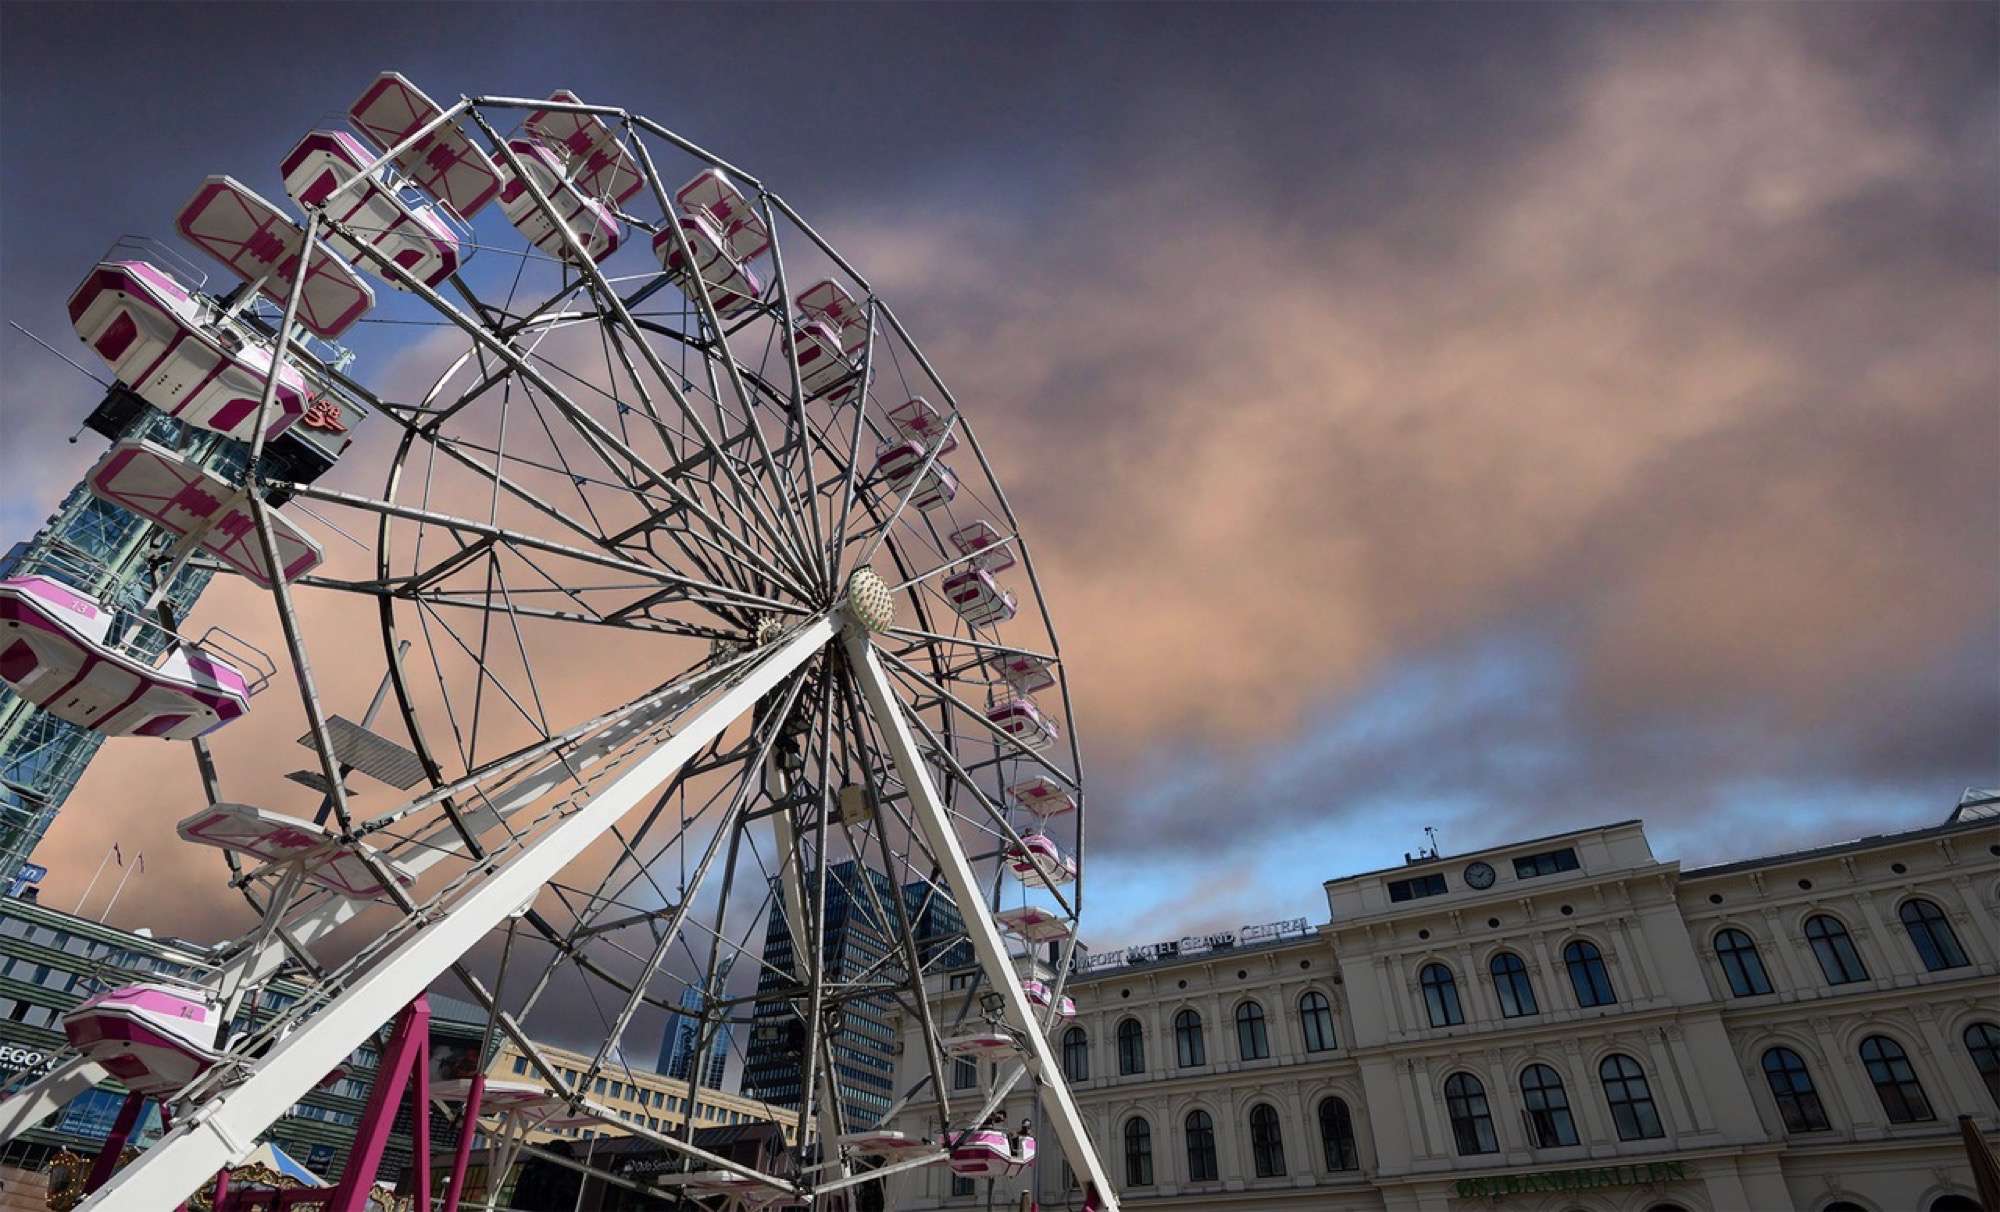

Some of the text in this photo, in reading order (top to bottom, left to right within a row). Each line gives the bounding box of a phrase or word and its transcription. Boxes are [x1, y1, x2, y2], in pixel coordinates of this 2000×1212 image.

[1128, 941, 1178, 958] HOTEL
[1181, 931, 1235, 950] GRAND
[1242, 917, 1310, 940] CENTRAL
